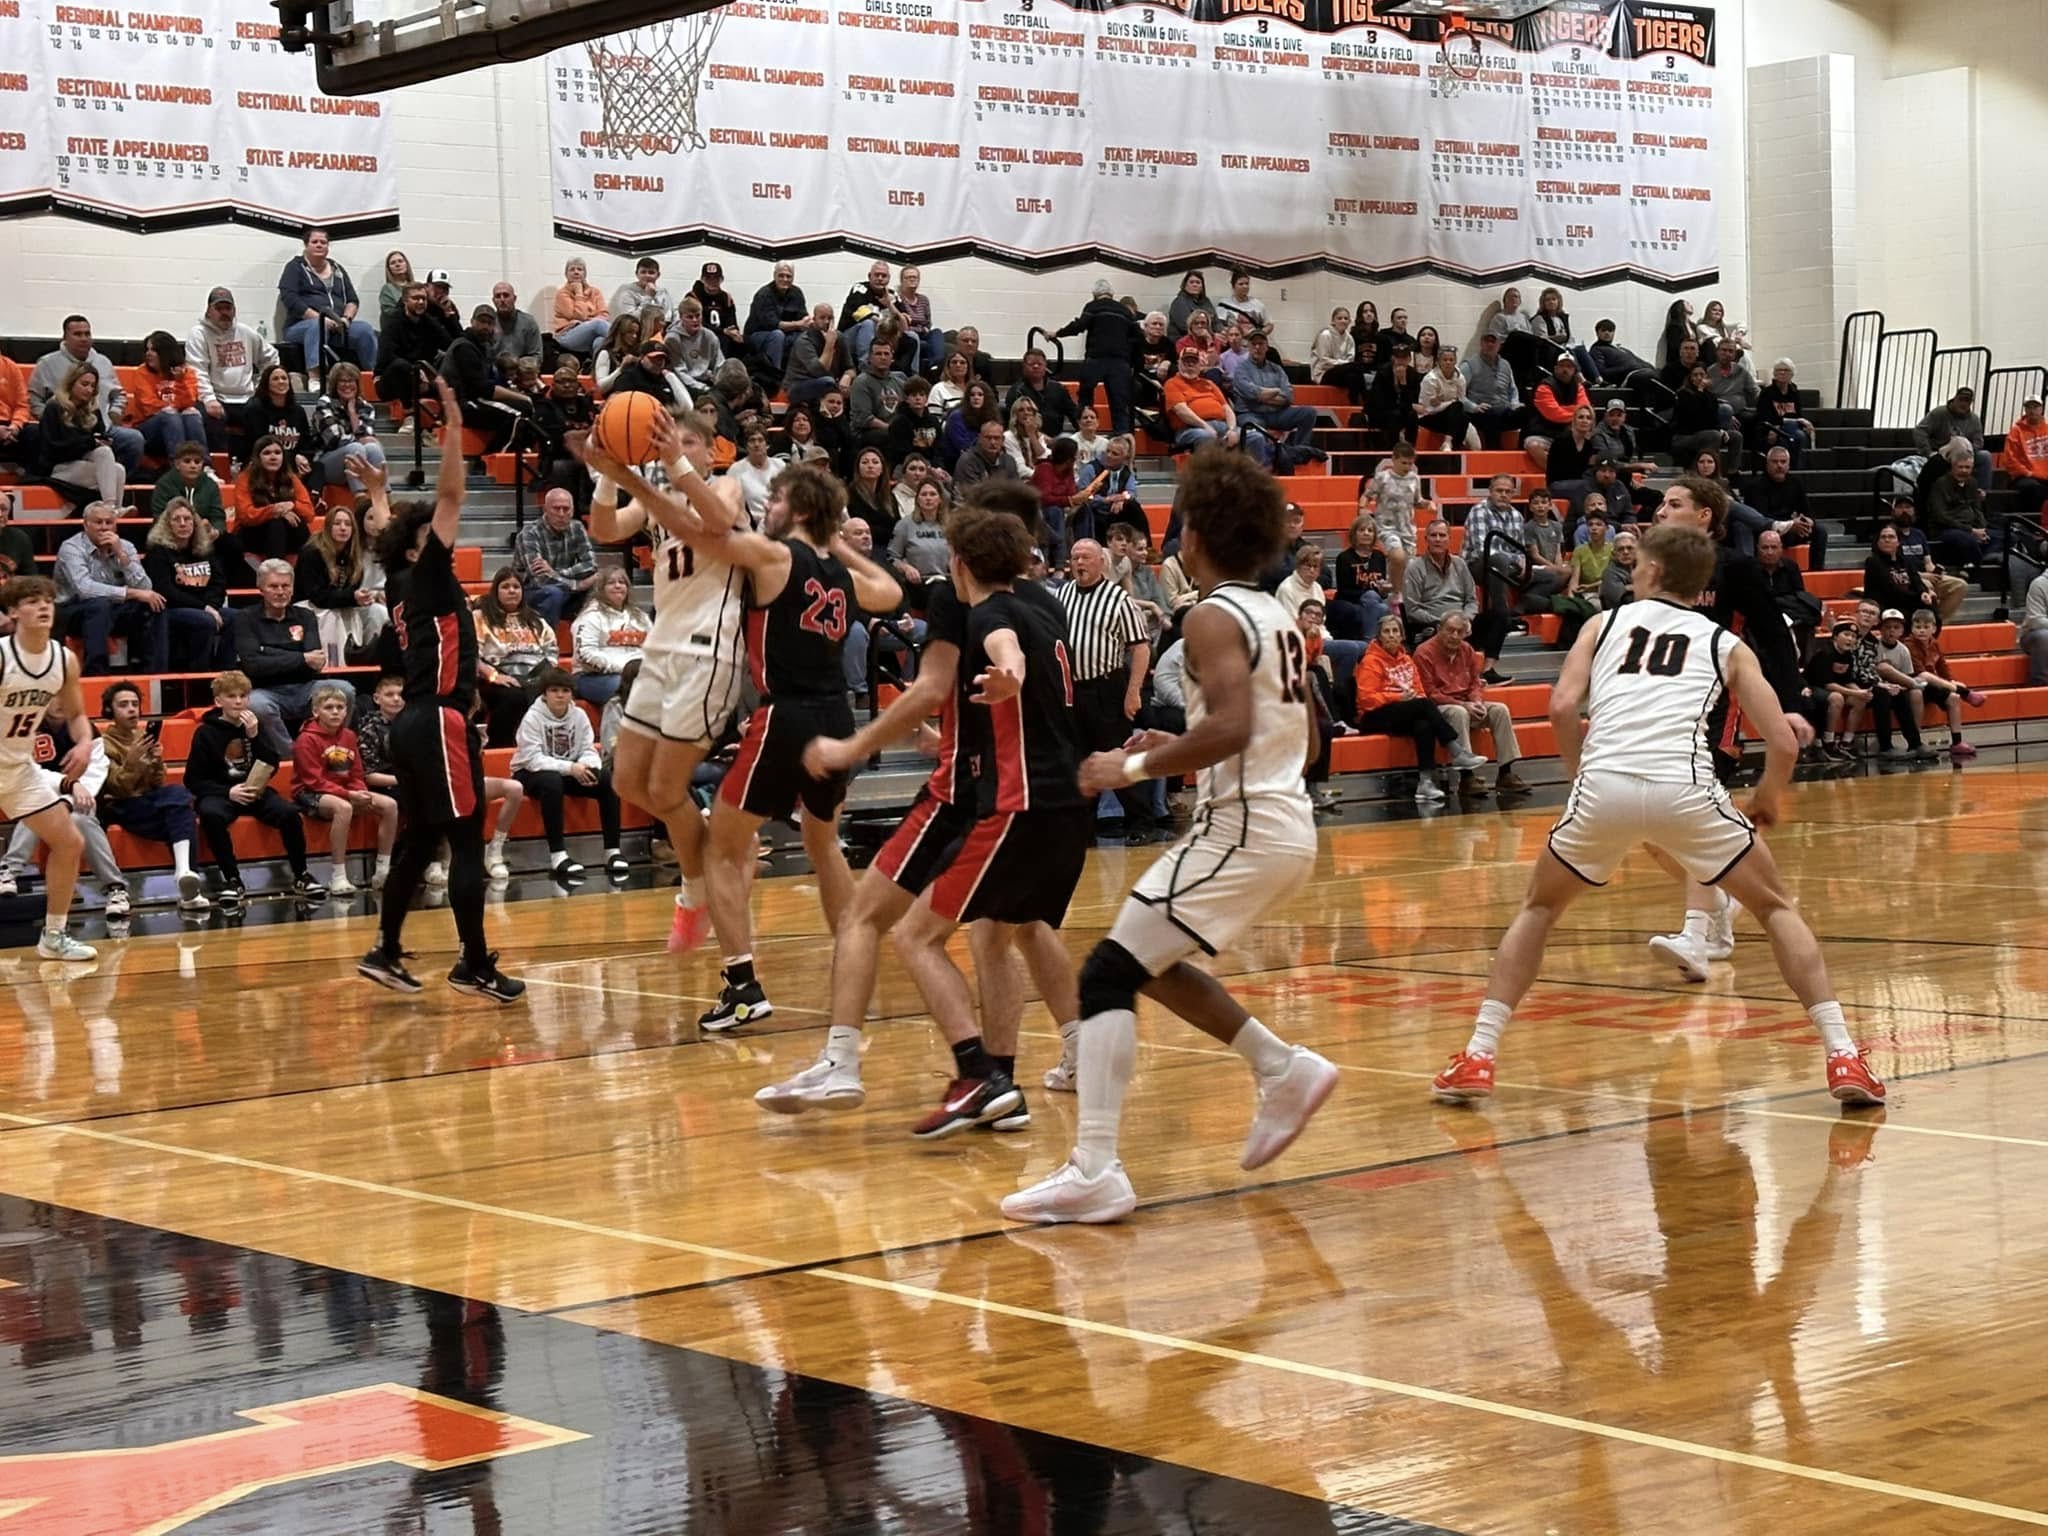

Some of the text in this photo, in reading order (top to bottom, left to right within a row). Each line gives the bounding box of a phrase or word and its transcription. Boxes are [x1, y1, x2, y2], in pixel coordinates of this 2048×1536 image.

[770, 5, 829, 24] CHAMPIONS
[866, 0, 933, 17] GIRLS SOCCER
[55, 5, 203, 35] REGIONAL CHAMPIONS
[838, 11, 960, 36] CONFERENCE CHAMPIONS
[1003, 13, 1050, 29] SOFTBALL
[969, 24, 1085, 48] CONFERENCE CHAMPIONS
[1107, 22, 1189, 42] BOYS SWIM & DIVE
[1633, 18, 1705, 57] TIGERS
[1098, 36, 1145, 53] SECTIONAL
[1148, 41, 1197, 58] CHAMPIONS
[1223, 33, 1303, 51] GIRLS SWIM & DIVE
[1330, 42, 1412, 61] BOYS TRACK & FIELD
[1215, 46, 1309, 67] SECTIONAL CHAMPIONS
[1321, 56, 1373, 73] CONFERENCE
[1376, 60, 1420, 76] CHAMPIONS
[1459, 53, 1516, 70] TRACK & FIELD
[709, 64, 825, 87] REGIONAL CHAMPIONS
[1552, 61, 1600, 76] VOLLEYBALL
[1650, 71, 1689, 83] WRESTLING
[57, 77, 212, 105] SECTIONAL CHAMPIONS
[848, 74, 955, 97] REGIONAL CHAMPIONS
[1530, 73, 1621, 92] CONFERENCE CHAMPIONS
[1627, 80, 1712, 99] CONFERENCE CHAMPIONS
[237, 91, 381, 117] SECTIONAL CHAMPIONS
[978, 86, 1079, 107] REGIONAL CHAMPIONS
[710, 128, 829, 150] SECTIONAL CHAMPIONS
[1537, 127, 1617, 144] REGIONAL CHAMPIONS
[1633, 133, 1707, 150] REGIONAL CHAMPIONS
[67, 136, 209, 163] STATE APPEARANCES
[847, 137, 960, 158] SECTIONAL CHAMPIONS
[979, 146, 1084, 167] SECTIONAL CHAMPIONS
[1104, 147, 1198, 166] STATE APPEARANCES
[1477, 142, 1520, 157] CHAMPIONS
[246, 148, 378, 173] STATE APPEARANCES
[1221, 154, 1310, 172] STATE APPEARANCES
[593, 174, 664, 192] SEMI-FINALS
[752, 182, 792, 200] ELITE-8
[1536, 180, 1621, 196] SECTIONAL CHAMPIONS
[1632, 184, 1711, 201] SECTIONAL CHAMPIONS
[888, 190, 925, 206] ELITE-8
[1016, 198, 1053, 214] ELITE-8
[1334, 198, 1418, 215] STATE APPEARANCES
[1440, 204, 1519, 221] STATE APPEARANCES
[1566, 225, 1594, 239] ELITE-8
[1660, 229, 1687, 243] ELITE-8
[668, 545, 694, 581] 11
[800, 577, 847, 642] 23
[1617, 625, 1691, 677] 10
[1055, 639, 1073, 707] 1
[1276, 629, 1305, 704] 13
[4, 689, 55, 708] BYRO
[6, 712, 37, 738] 15
